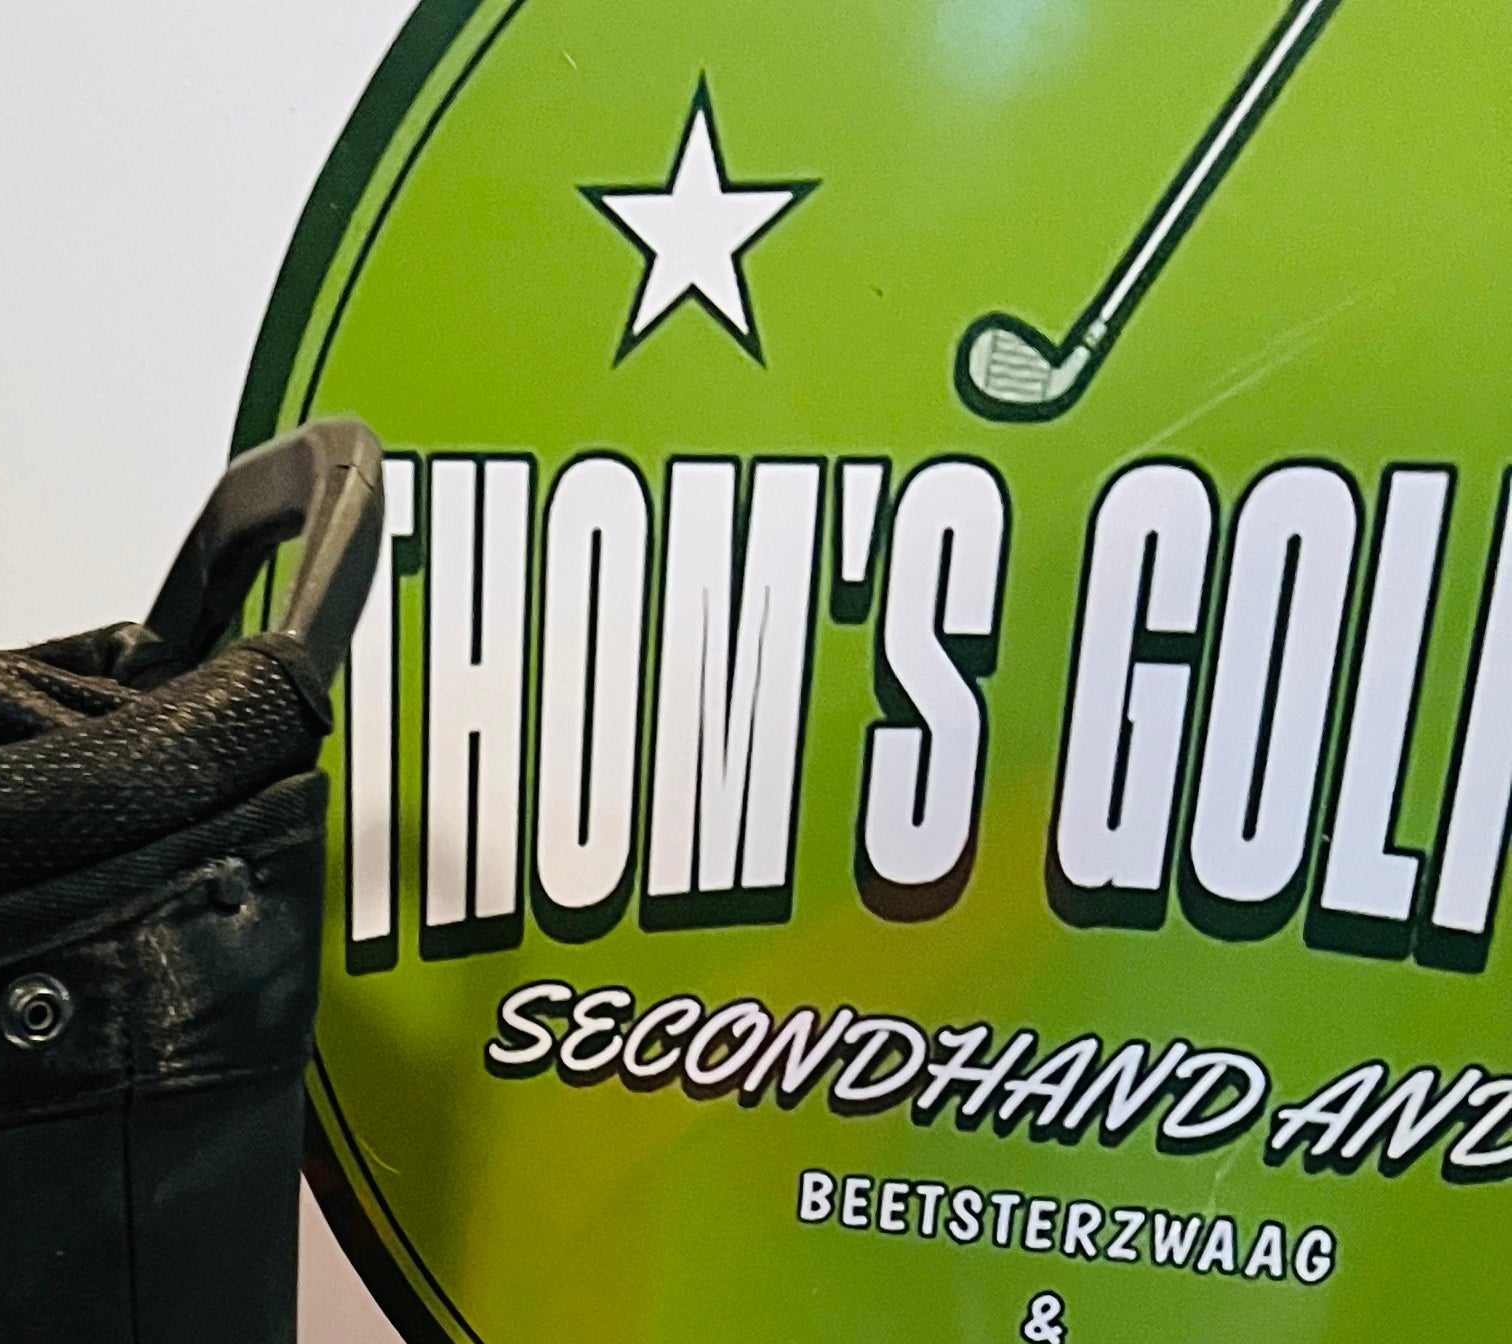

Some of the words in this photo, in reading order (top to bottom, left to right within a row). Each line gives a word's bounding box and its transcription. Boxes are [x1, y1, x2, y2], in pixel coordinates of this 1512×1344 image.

[335, 456, 1006, 944] THOM'S
[488, 985, 1267, 1139] SECONDHAND
[800, 1170, 1336, 1284] BEETSTERZWAAG
